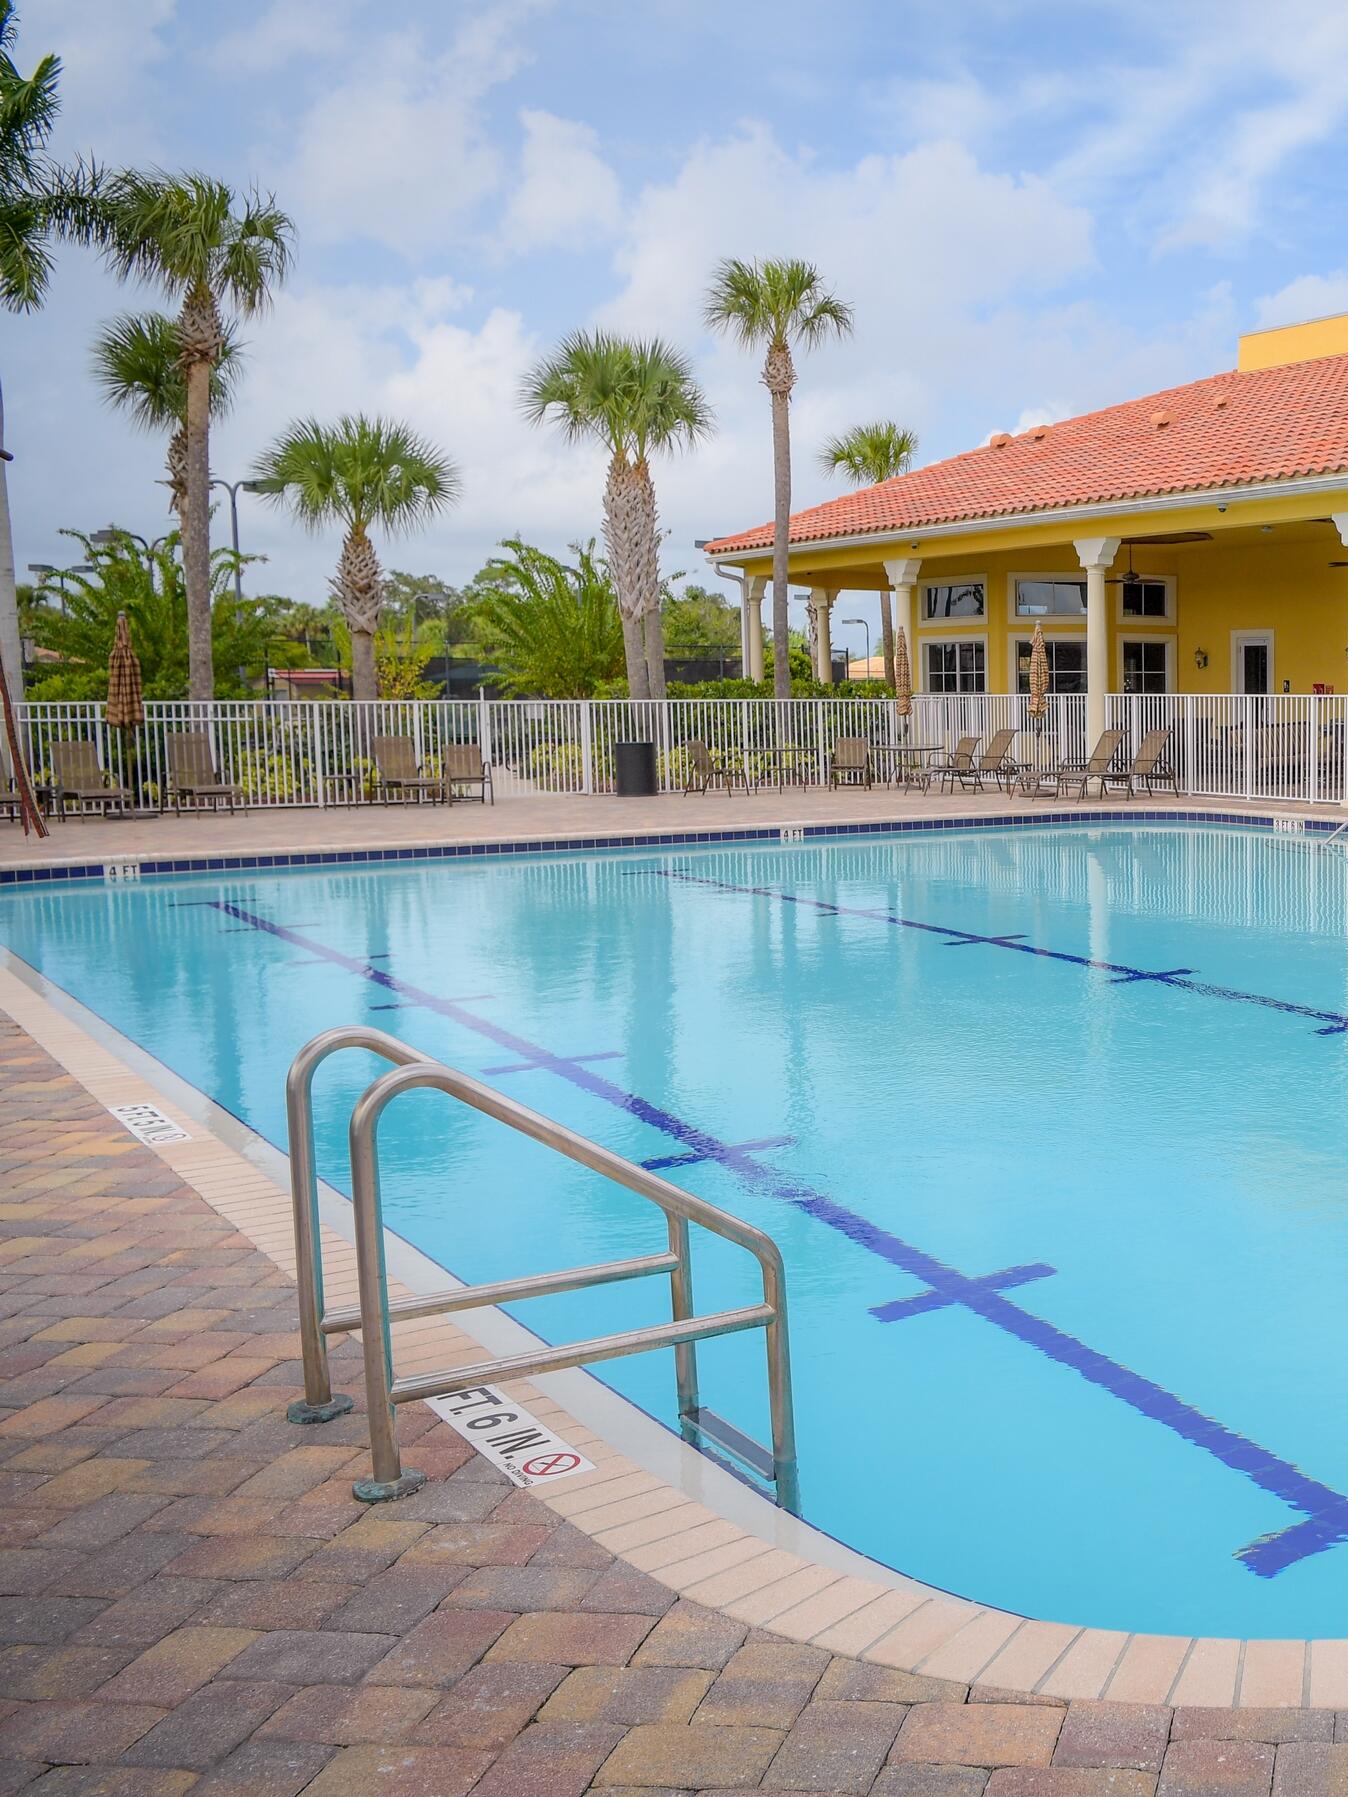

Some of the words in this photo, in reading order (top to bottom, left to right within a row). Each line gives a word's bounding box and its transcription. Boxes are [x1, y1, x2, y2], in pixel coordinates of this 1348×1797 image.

[1282, 820, 1288, 829] FT
[109, 866, 116, 875] 4
[123, 865, 137, 875] FT
[117, 1104, 150, 1112] 5
[133, 1119, 166, 1127] 5
[436, 1386, 504, 1415] FT.
[466, 1412, 519, 1430] 6
[485, 1427, 551, 1460] IN.
[503, 1462, 516, 1471] NO
[511, 1469, 534, 1486] DIVING
